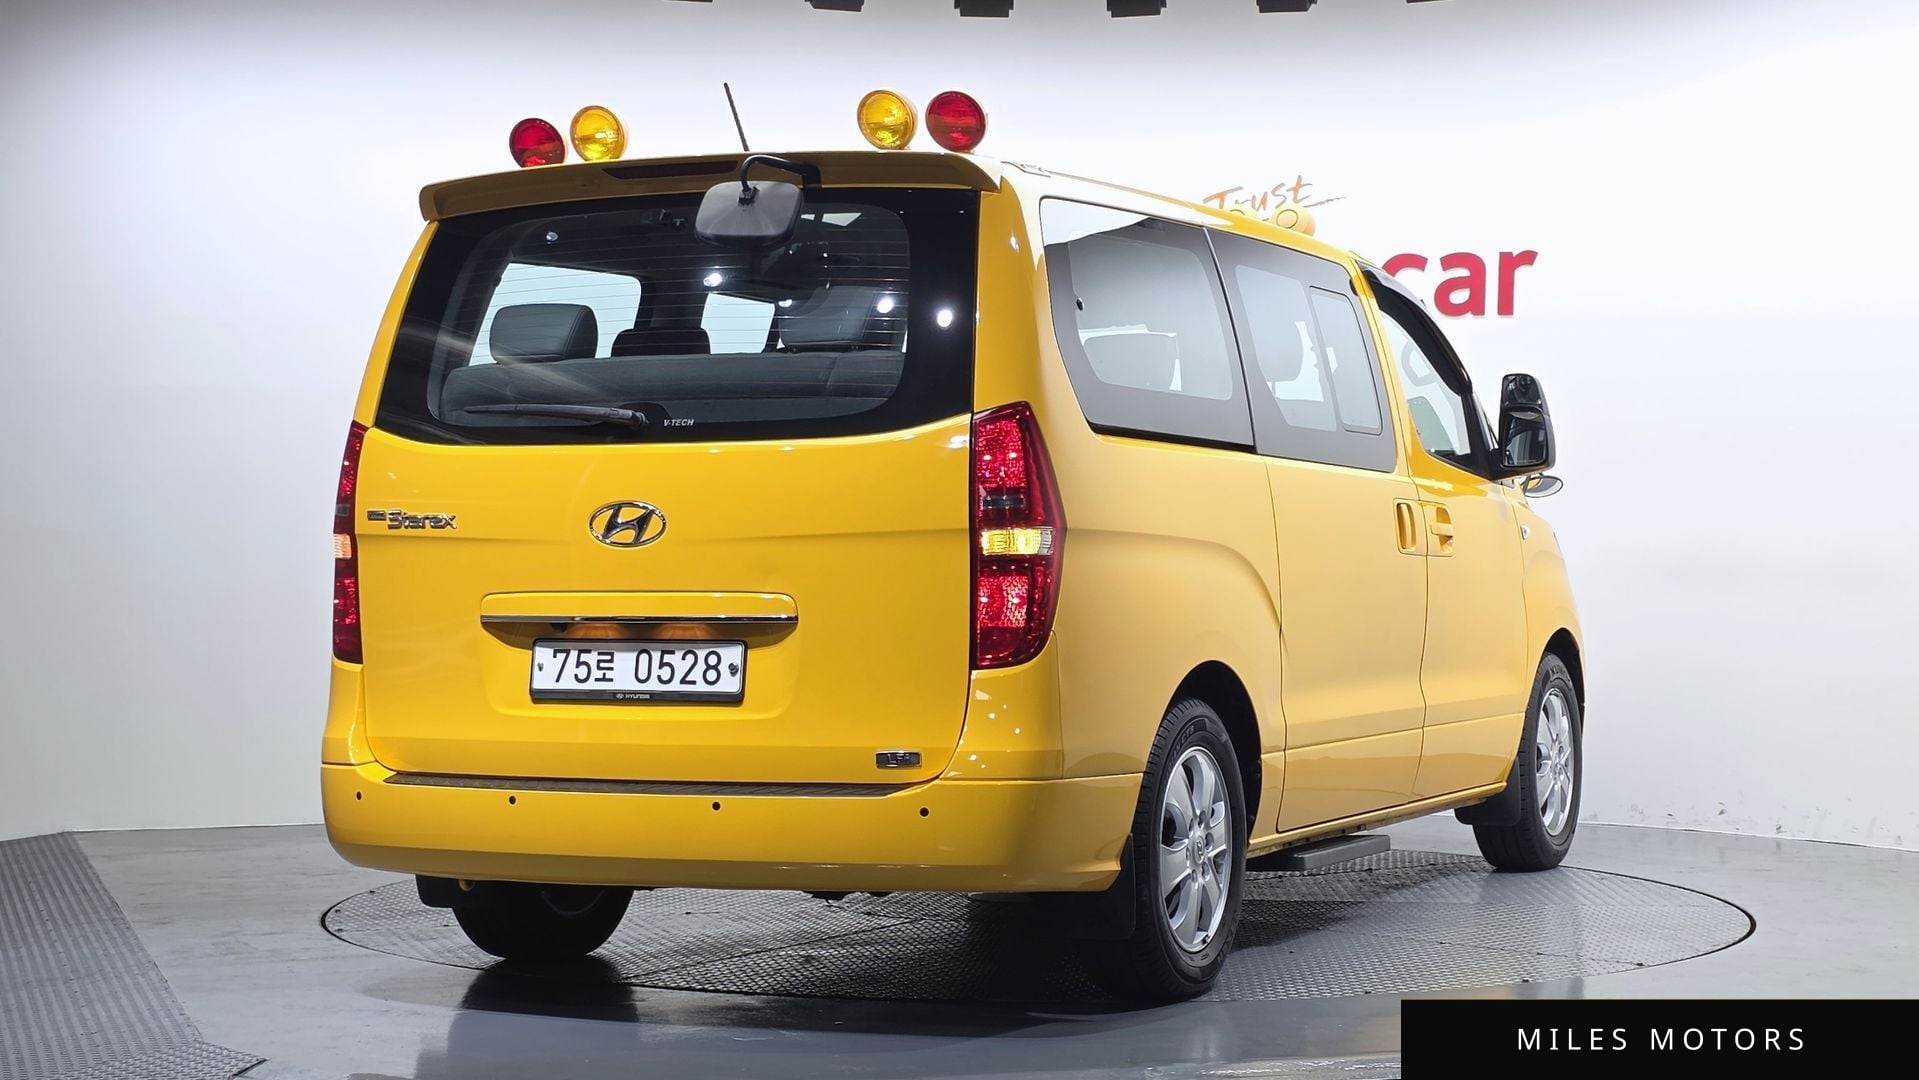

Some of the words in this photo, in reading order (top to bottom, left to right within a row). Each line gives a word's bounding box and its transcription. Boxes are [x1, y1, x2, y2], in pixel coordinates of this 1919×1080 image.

[663, 418, 695, 427] V-TECH
[387, 509, 458, 530] Starex
[552, 646, 615, 684] 75로
[634, 646, 722, 686] 0528
